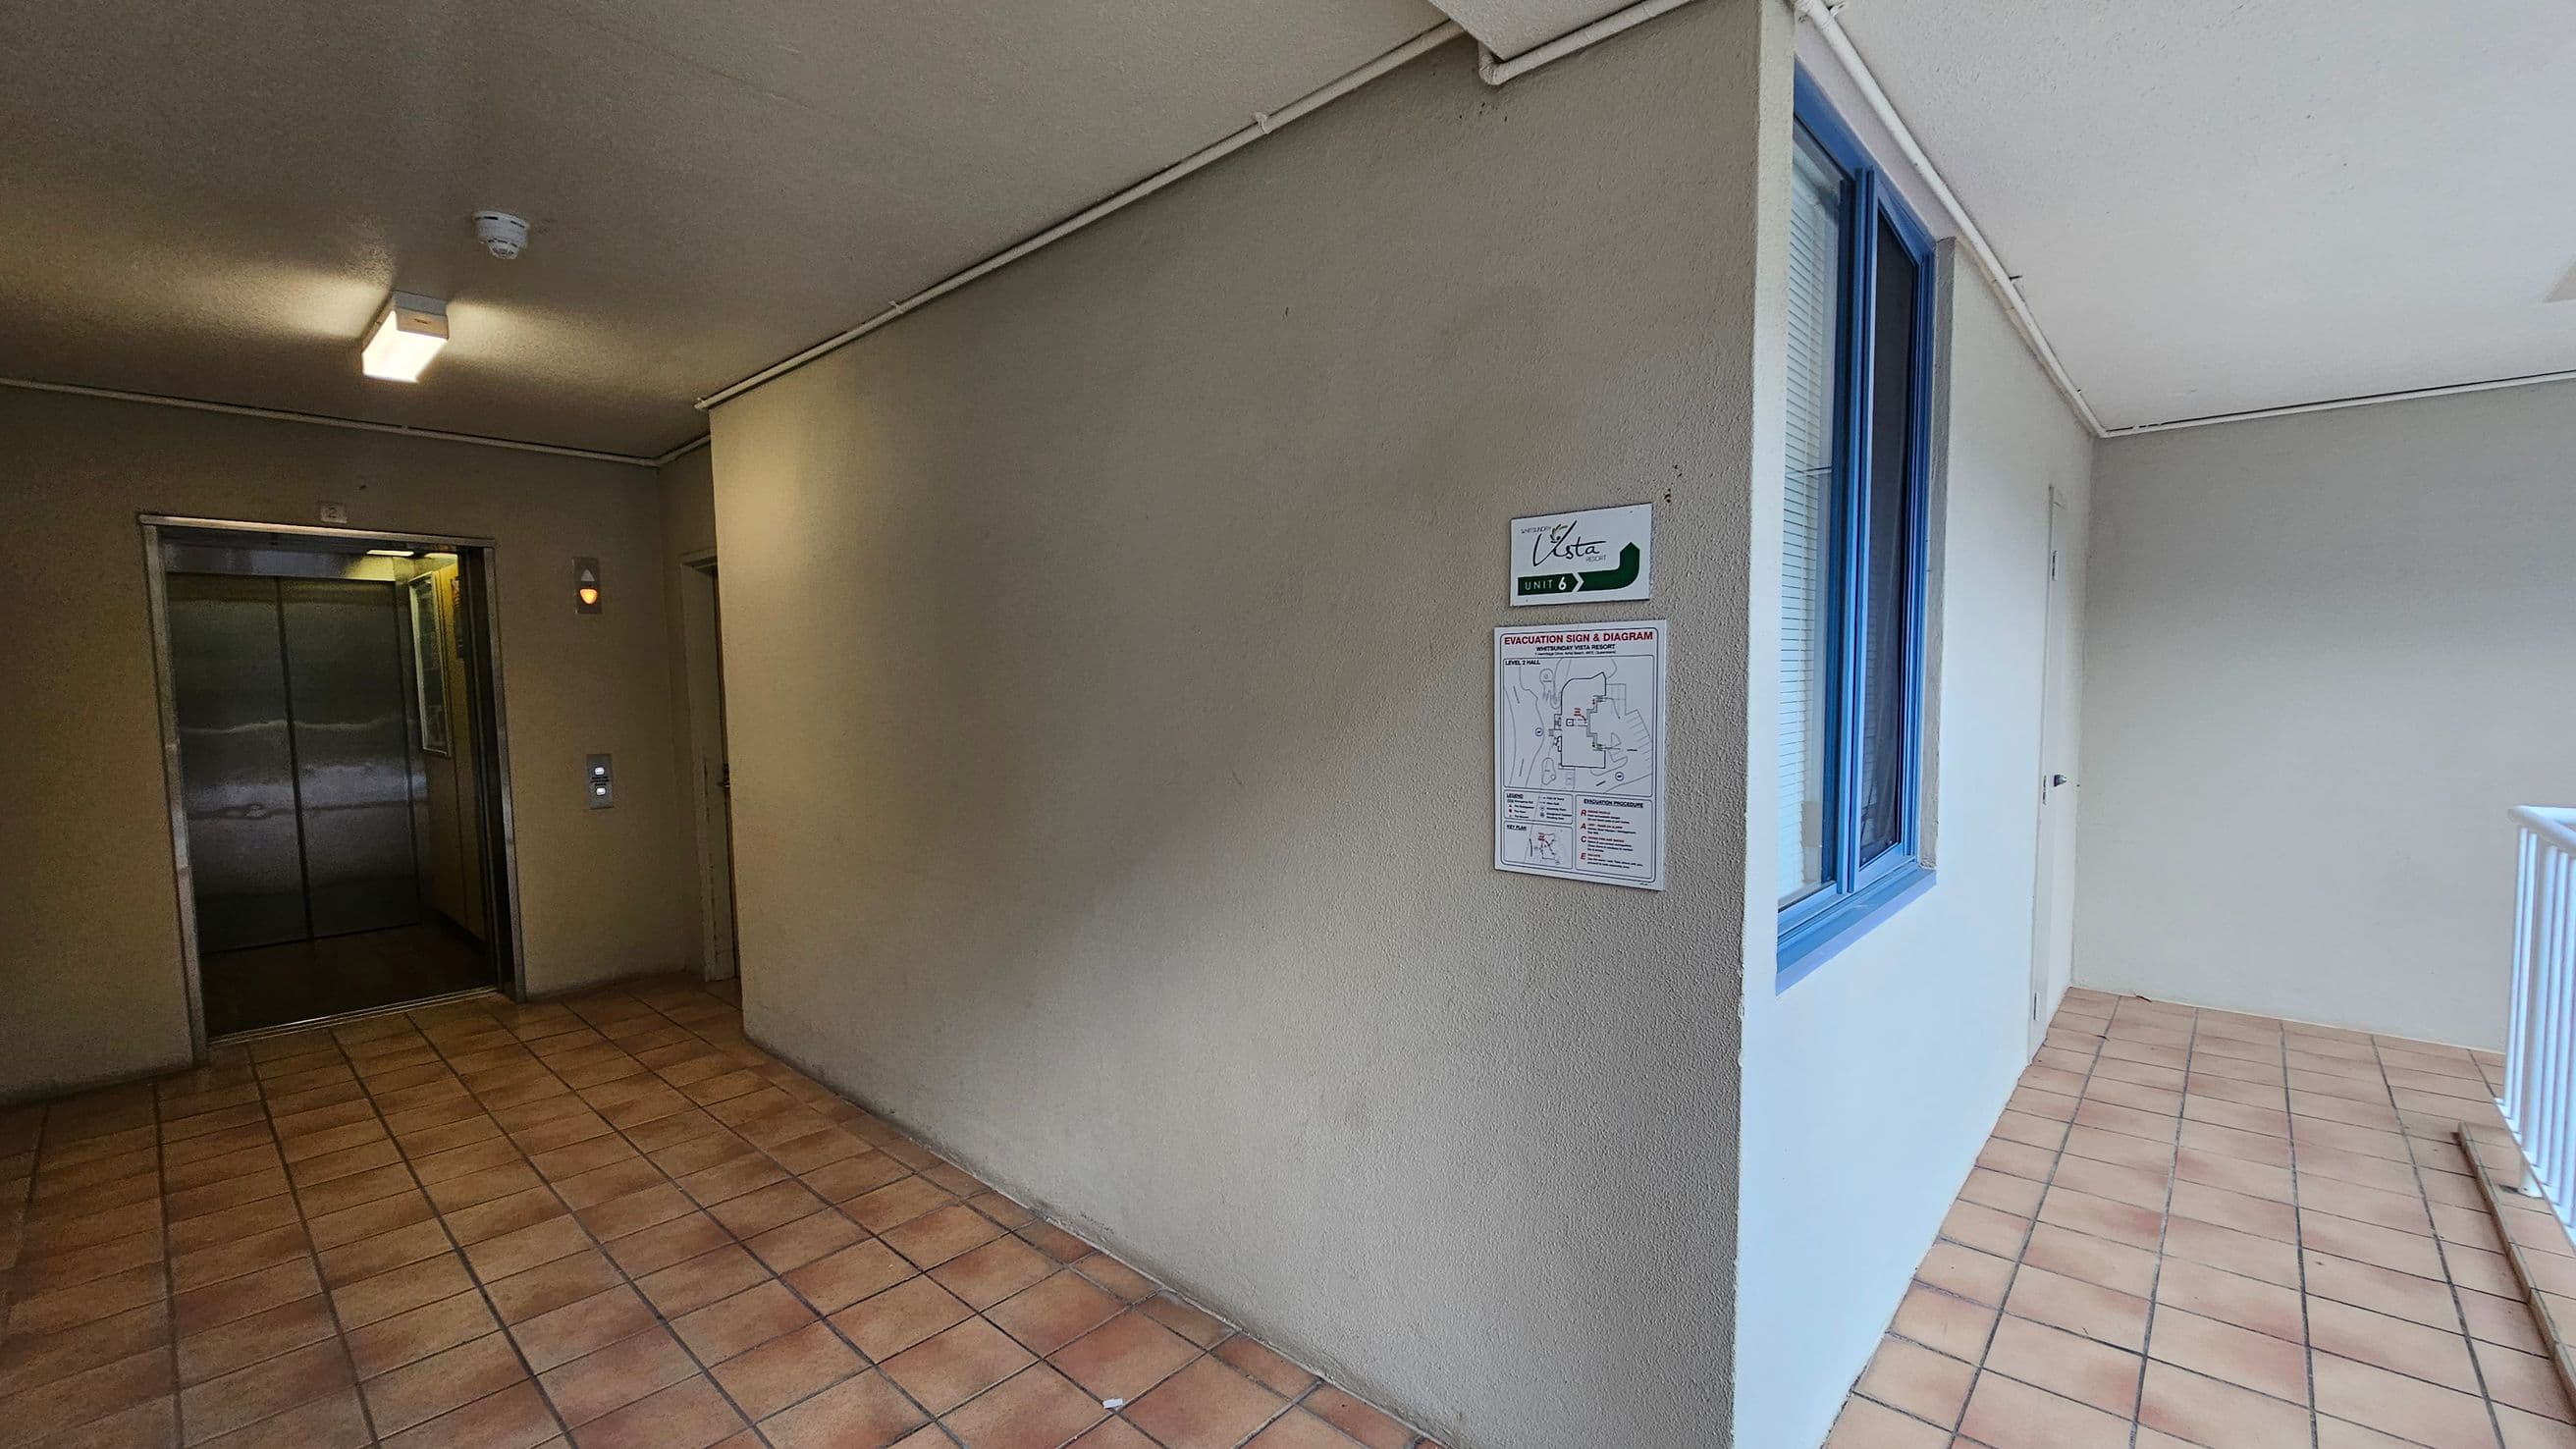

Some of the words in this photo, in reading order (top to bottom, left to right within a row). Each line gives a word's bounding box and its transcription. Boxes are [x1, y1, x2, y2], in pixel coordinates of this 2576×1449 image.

[1532, 519, 1607, 567] Vista
[1525, 579, 1553, 591] UNIT
[1558, 576, 1567, 591] 6
[1504, 632, 1564, 645] EVACUATION
[1566, 632, 1590, 643] SIGN
[1592, 632, 1600, 642] &
[1603, 631, 1653, 642] DIAGRAM
[1613, 800, 1643, 809] PROCEDURE
